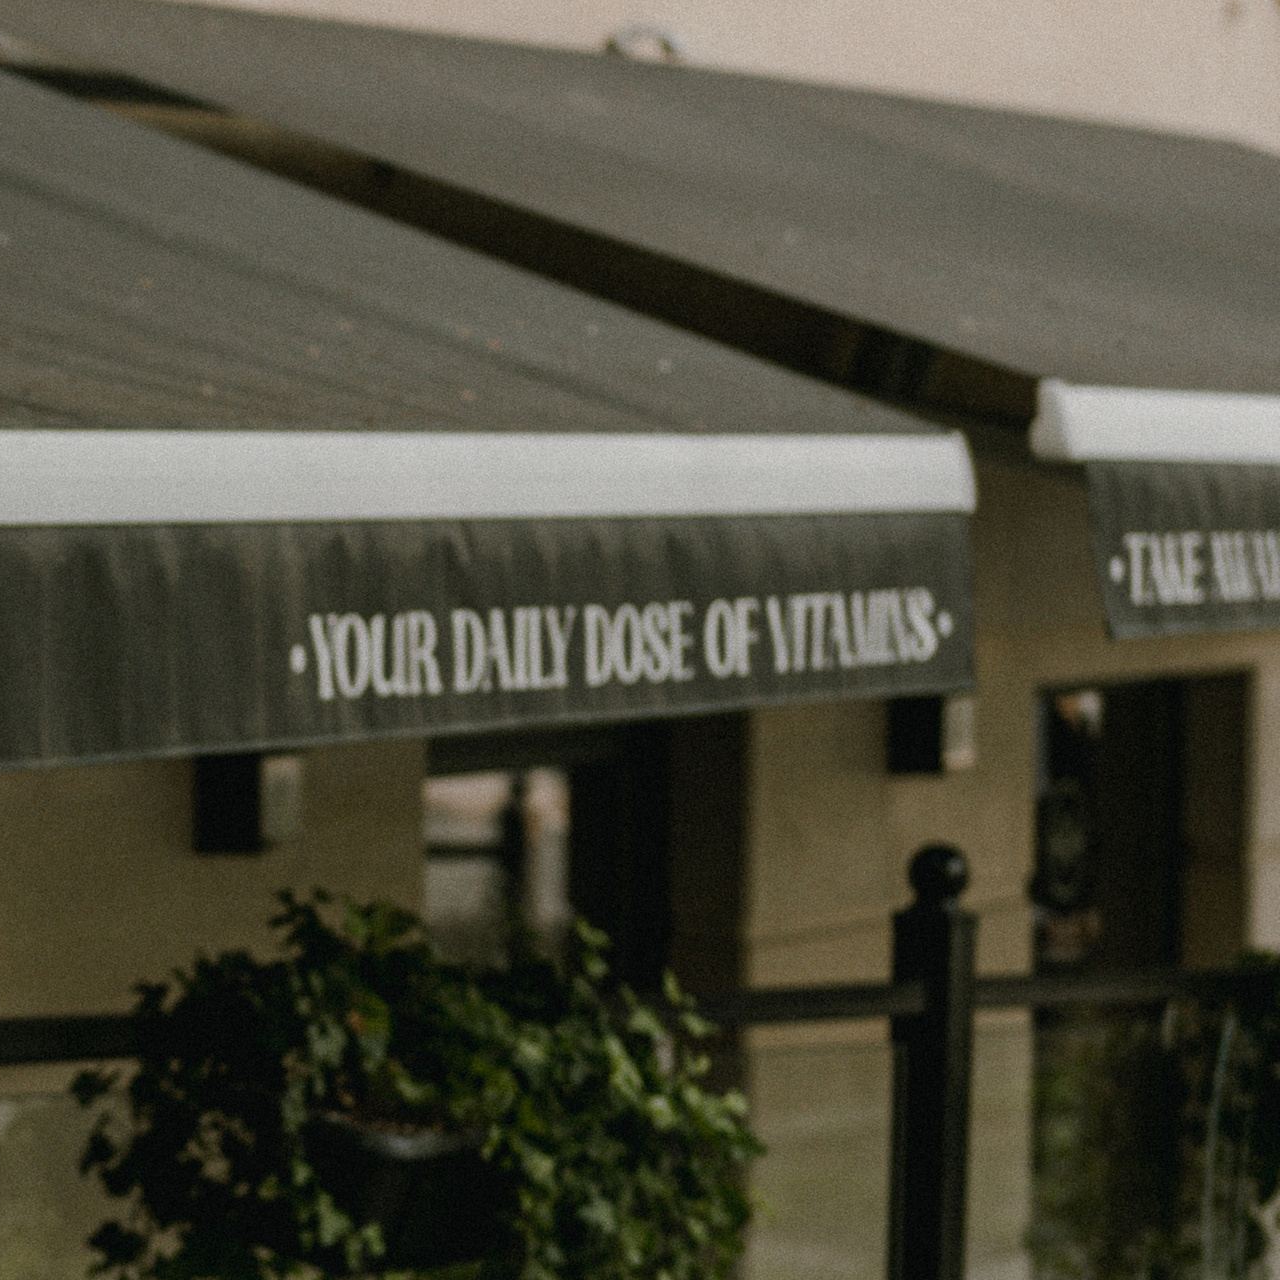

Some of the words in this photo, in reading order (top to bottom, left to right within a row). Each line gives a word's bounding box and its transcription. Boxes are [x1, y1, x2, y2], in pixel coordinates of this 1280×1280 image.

[308, 610, 443, 700] YOUR
[450, 604, 576, 695] DAILY
[583, 601, 695, 688] DOSE
[703, 597, 760, 680] OF
[765, 586, 938, 675] VITAMINS
